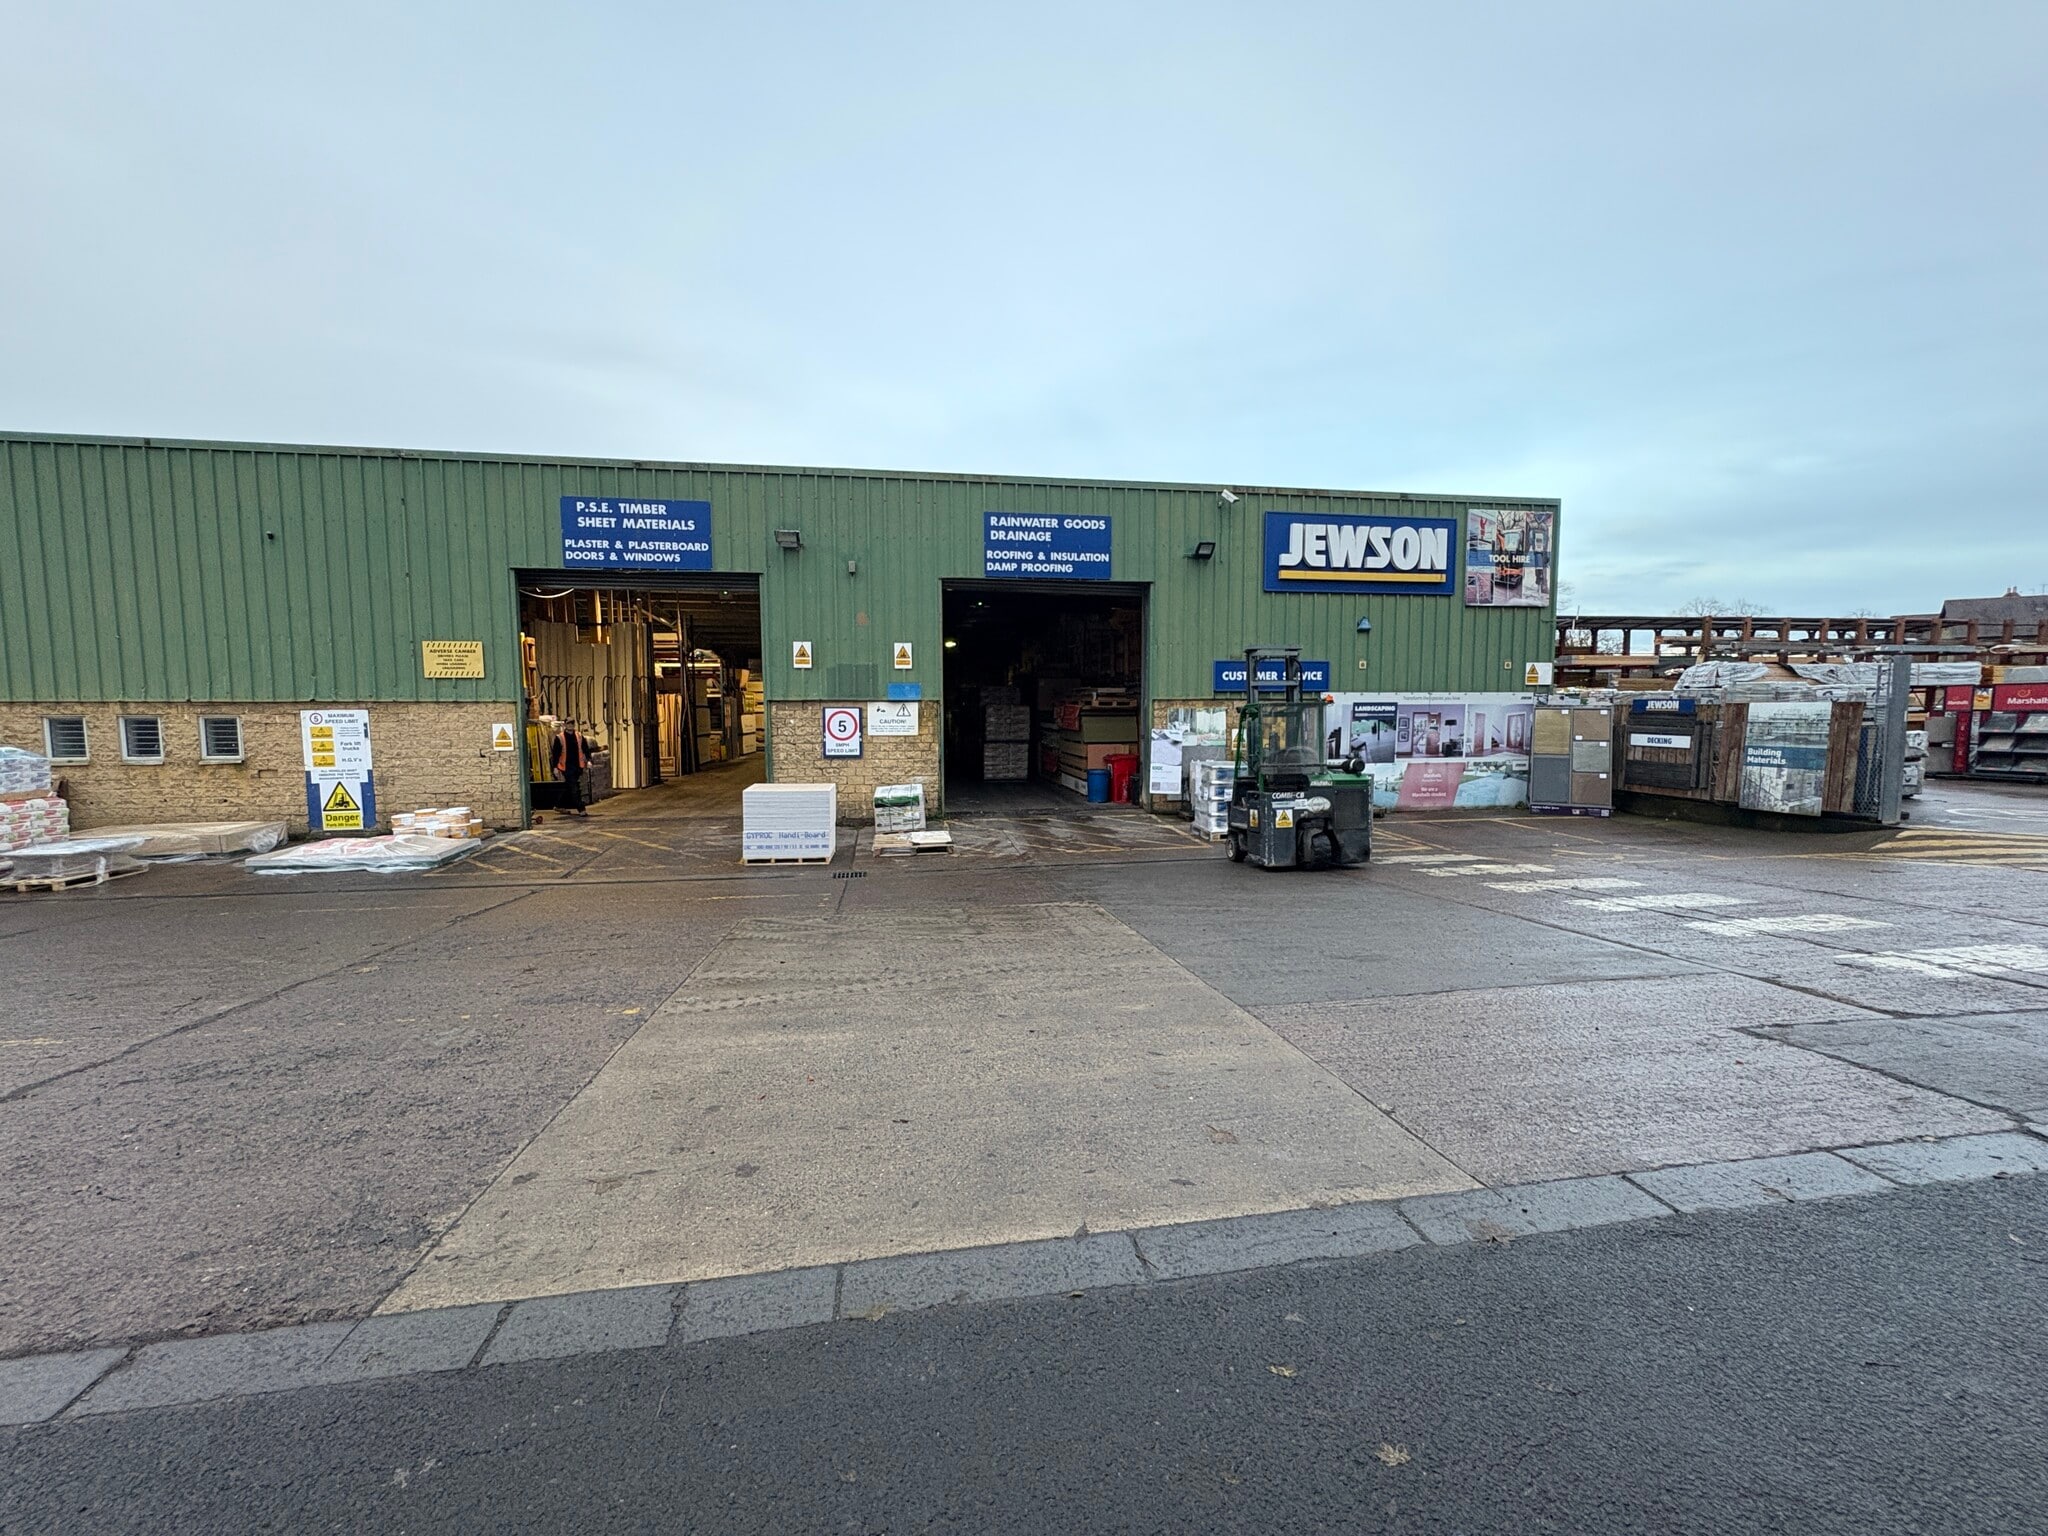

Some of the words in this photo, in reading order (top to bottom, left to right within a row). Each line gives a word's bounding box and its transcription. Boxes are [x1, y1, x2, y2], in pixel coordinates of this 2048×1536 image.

[576, 501, 613, 514] P.S.E.
[618, 503, 668, 515] TIMBER
[577, 517, 617, 528] SHEET
[623, 519, 695, 530] MATERIALS
[990, 516, 1059, 528] RAINWATER
[1063, 519, 1106, 530] GOODS
[990, 530, 1052, 542] DRAINAGE
[564, 539, 610, 549] PLASTER
[614, 540, 624, 550] &
[628, 541, 710, 552] PLASTERBOARD
[1278, 522, 1448, 570] JEWSON
[565, 550, 605, 561] DOORS
[609, 552, 619, 561] &
[623, 552, 681, 563] WINDOWS
[986, 550, 1034, 560] ROOFING
[1037, 551, 1046, 561] &
[1050, 552, 1110, 562] INSULATION
[1489, 554, 1511, 564] TOOL
[1512, 554, 1531, 564] HIRE
[986, 562, 1018, 572] DAMP
[1021, 563, 1074, 573] PROOFING
[1222, 671, 1278, 681] CUSTMER
[1282, 671, 1323, 681] SVICE
[1646, 700, 1680, 710] JEWSON
[838, 720, 848, 733] 5
[1647, 736, 1673, 745] DECKING
[1747, 748, 1782, 758] Building
[1747, 756, 1786, 765] Materials
[325, 814, 360, 822] Danger
[746, 831, 773, 840] GYPROC
